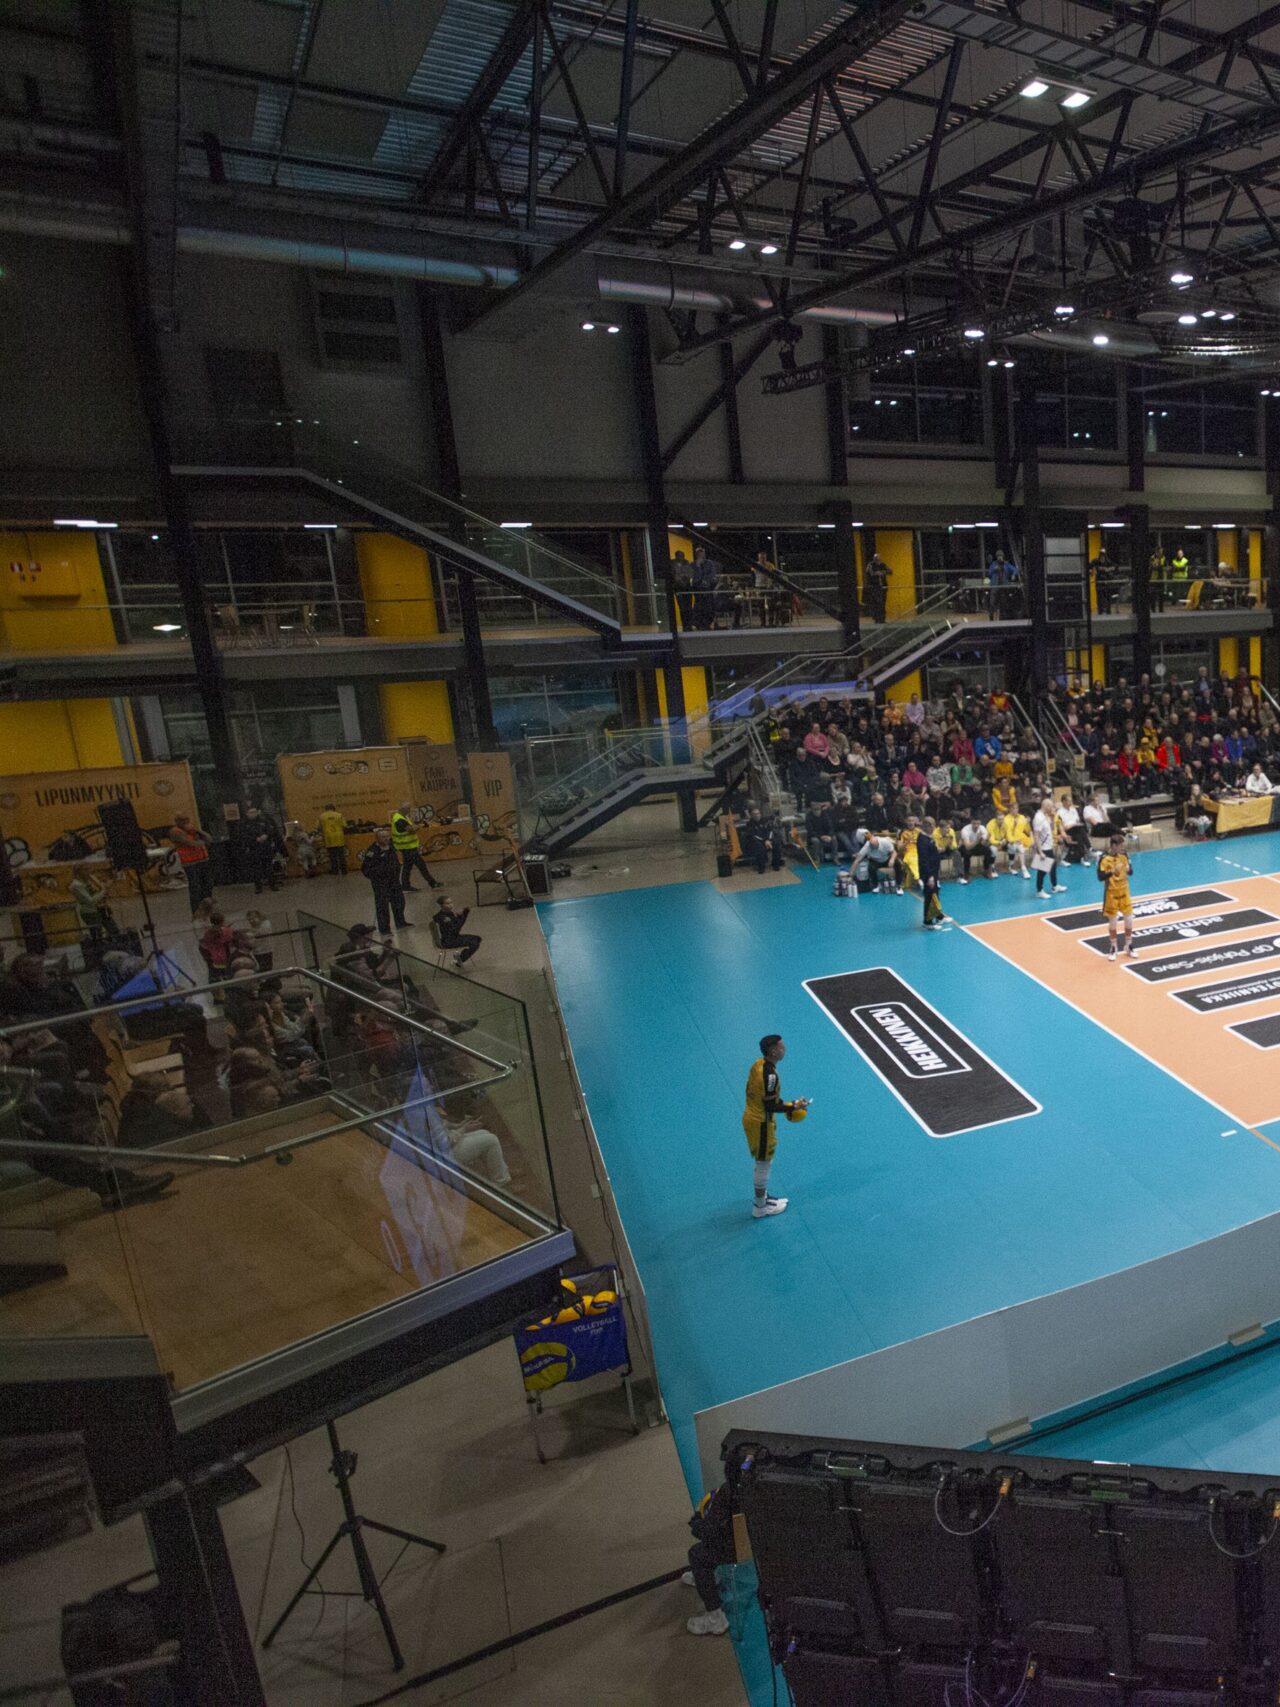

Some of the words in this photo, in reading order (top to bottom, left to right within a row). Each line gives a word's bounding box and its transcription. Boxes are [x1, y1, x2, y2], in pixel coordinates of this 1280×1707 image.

[34, 782, 140, 807] LIPUNMYYNTI
[483, 779, 503, 797] VIP
[869, 1007, 948, 1071] HEIKKINEN
[571, 1315, 618, 1334] VOLLEYBALL
